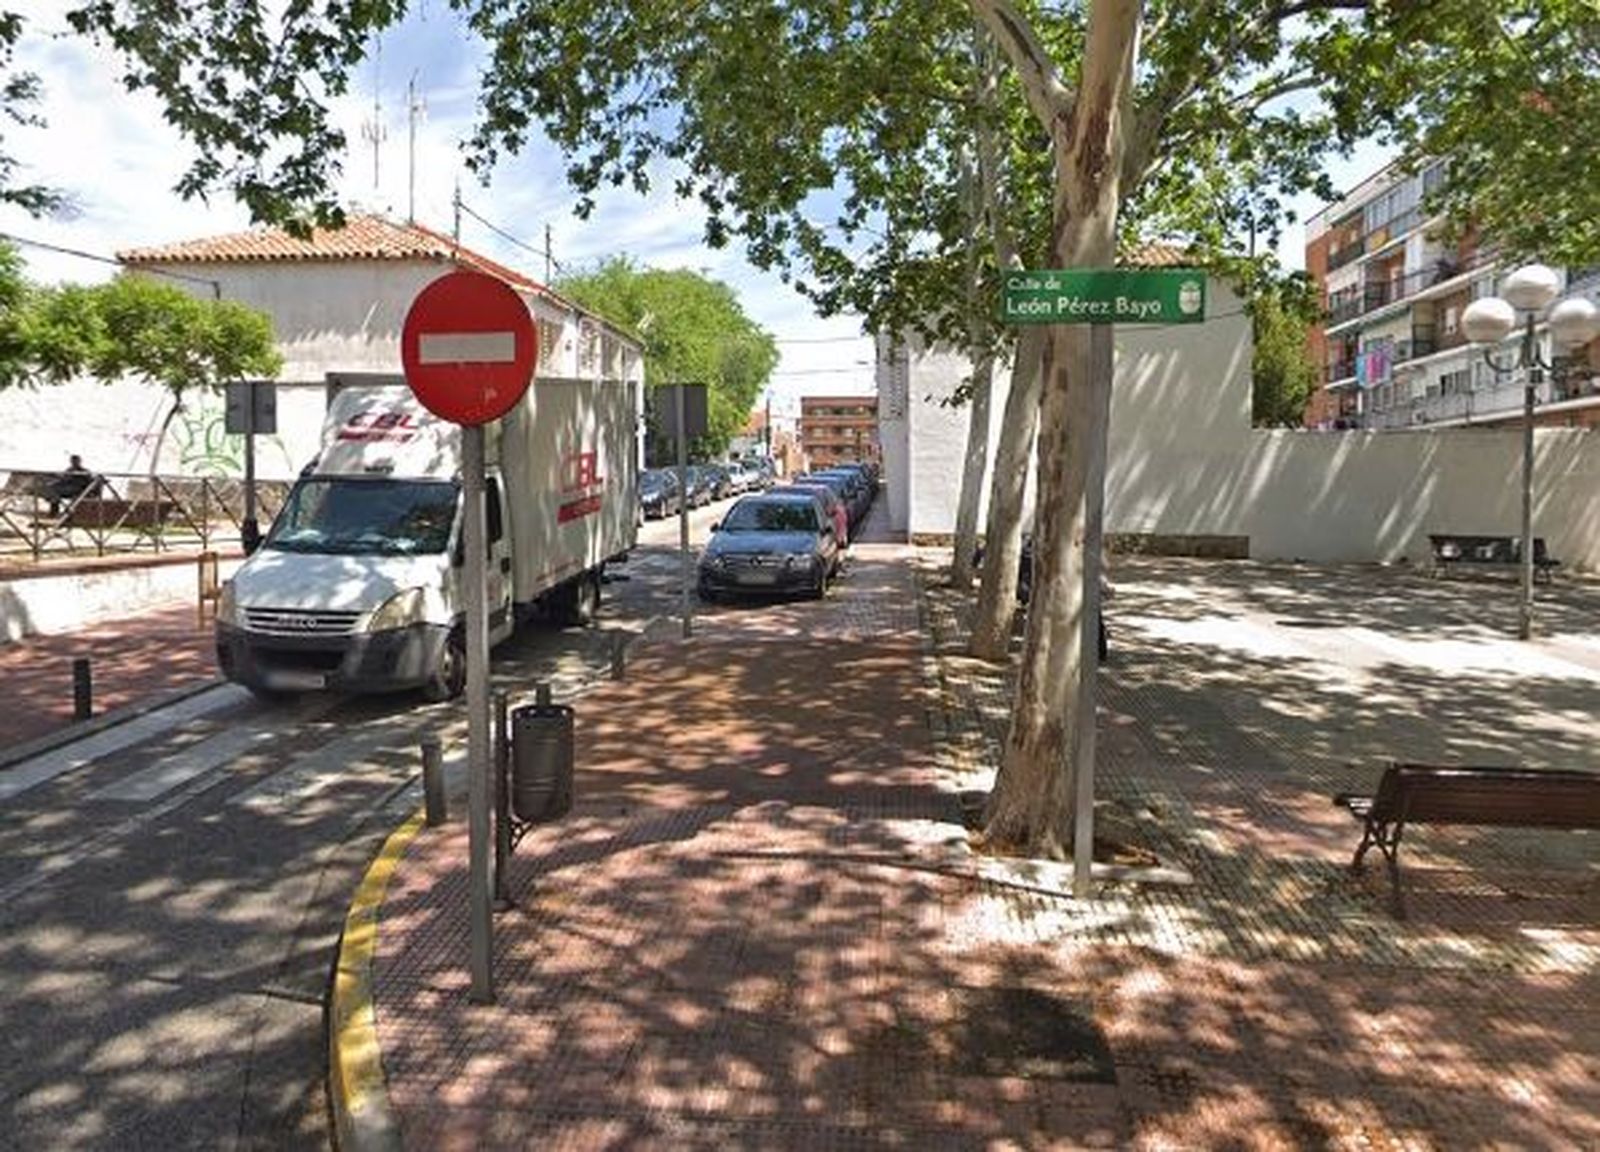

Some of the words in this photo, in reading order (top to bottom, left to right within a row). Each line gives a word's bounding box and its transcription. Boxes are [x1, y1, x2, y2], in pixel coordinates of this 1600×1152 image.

[1006, 277, 1041, 290] Calle
[1045, 276, 1062, 290] de
[1006, 297, 1052, 314] León
[1057, 297, 1111, 314] Pérez
[1116, 297, 1162, 318] Bayo
